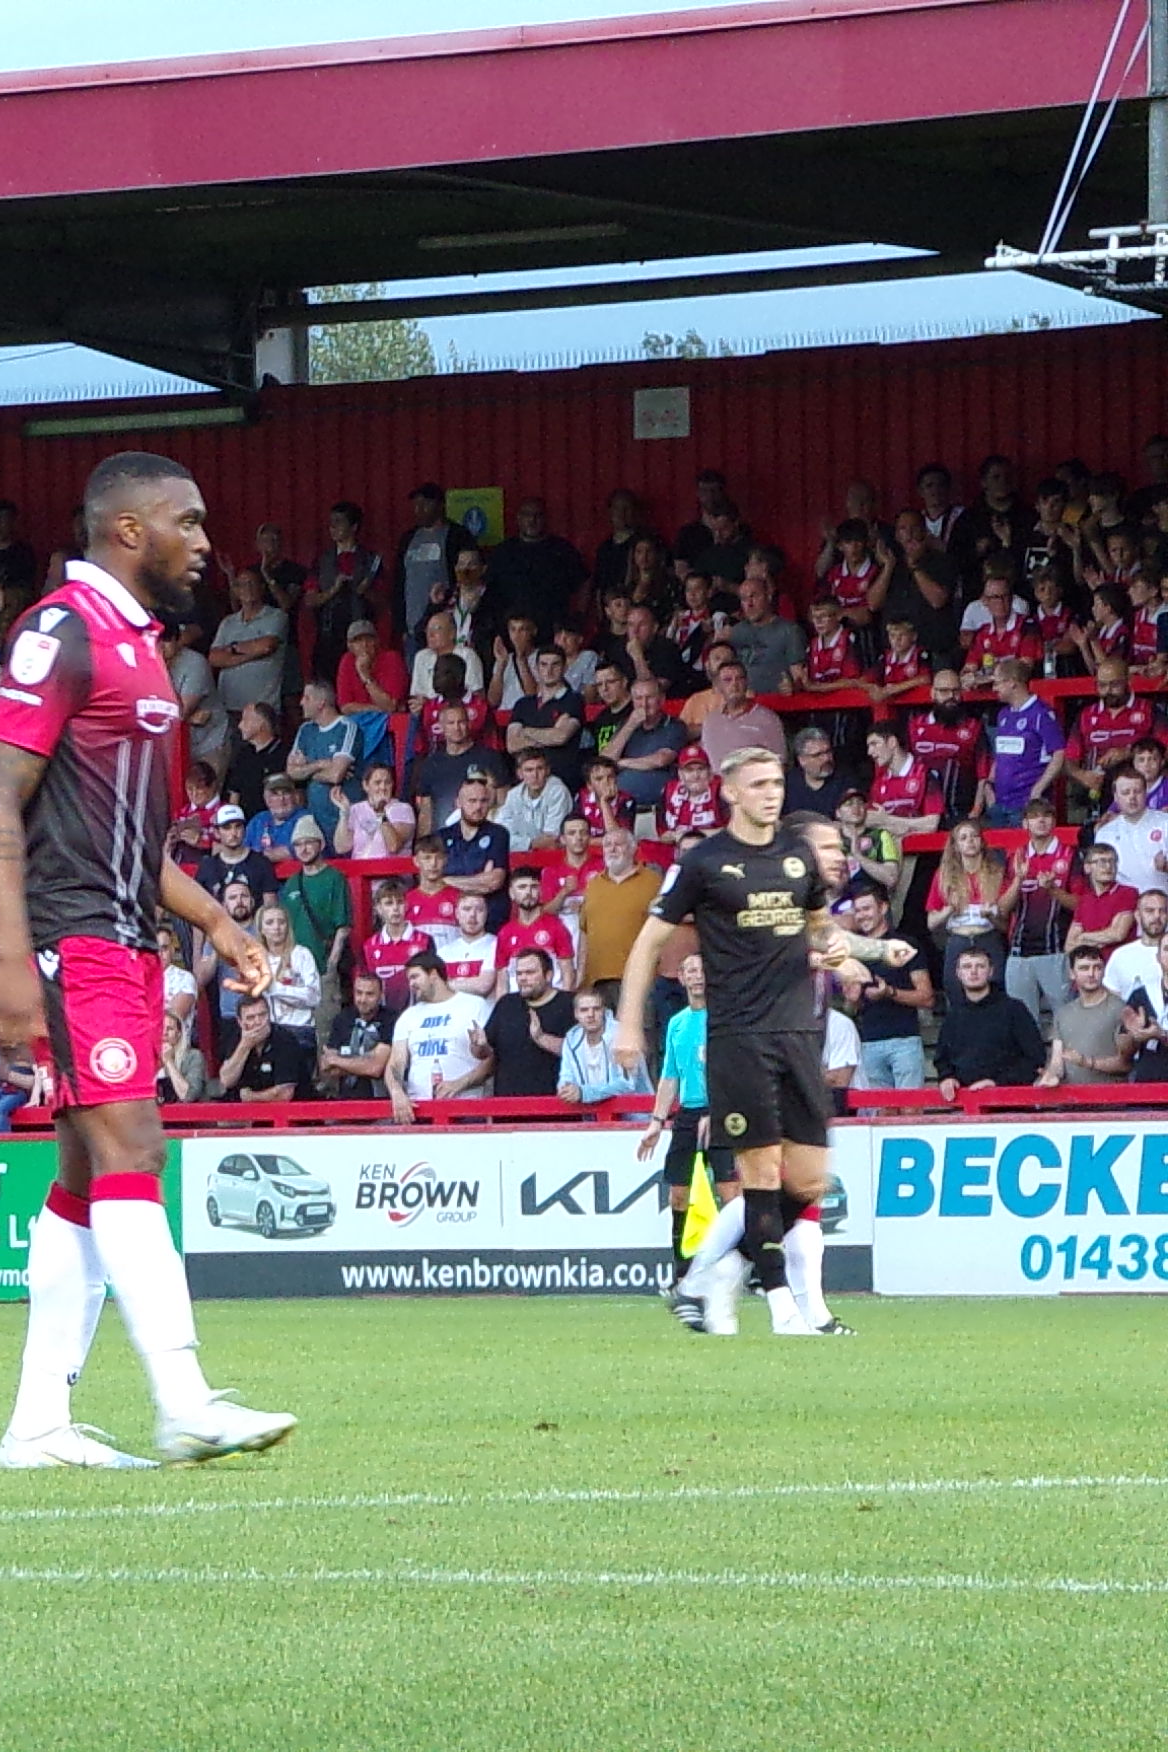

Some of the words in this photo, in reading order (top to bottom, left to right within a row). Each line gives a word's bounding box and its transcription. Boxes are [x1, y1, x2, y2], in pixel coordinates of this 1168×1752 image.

[359, 1163, 396, 1180] KEN
[355, 1180, 480, 1209] BROWN
[436, 1210, 477, 1222] GROUP
[342, 1257, 672, 1288] www.kenbrownkia.co.u
